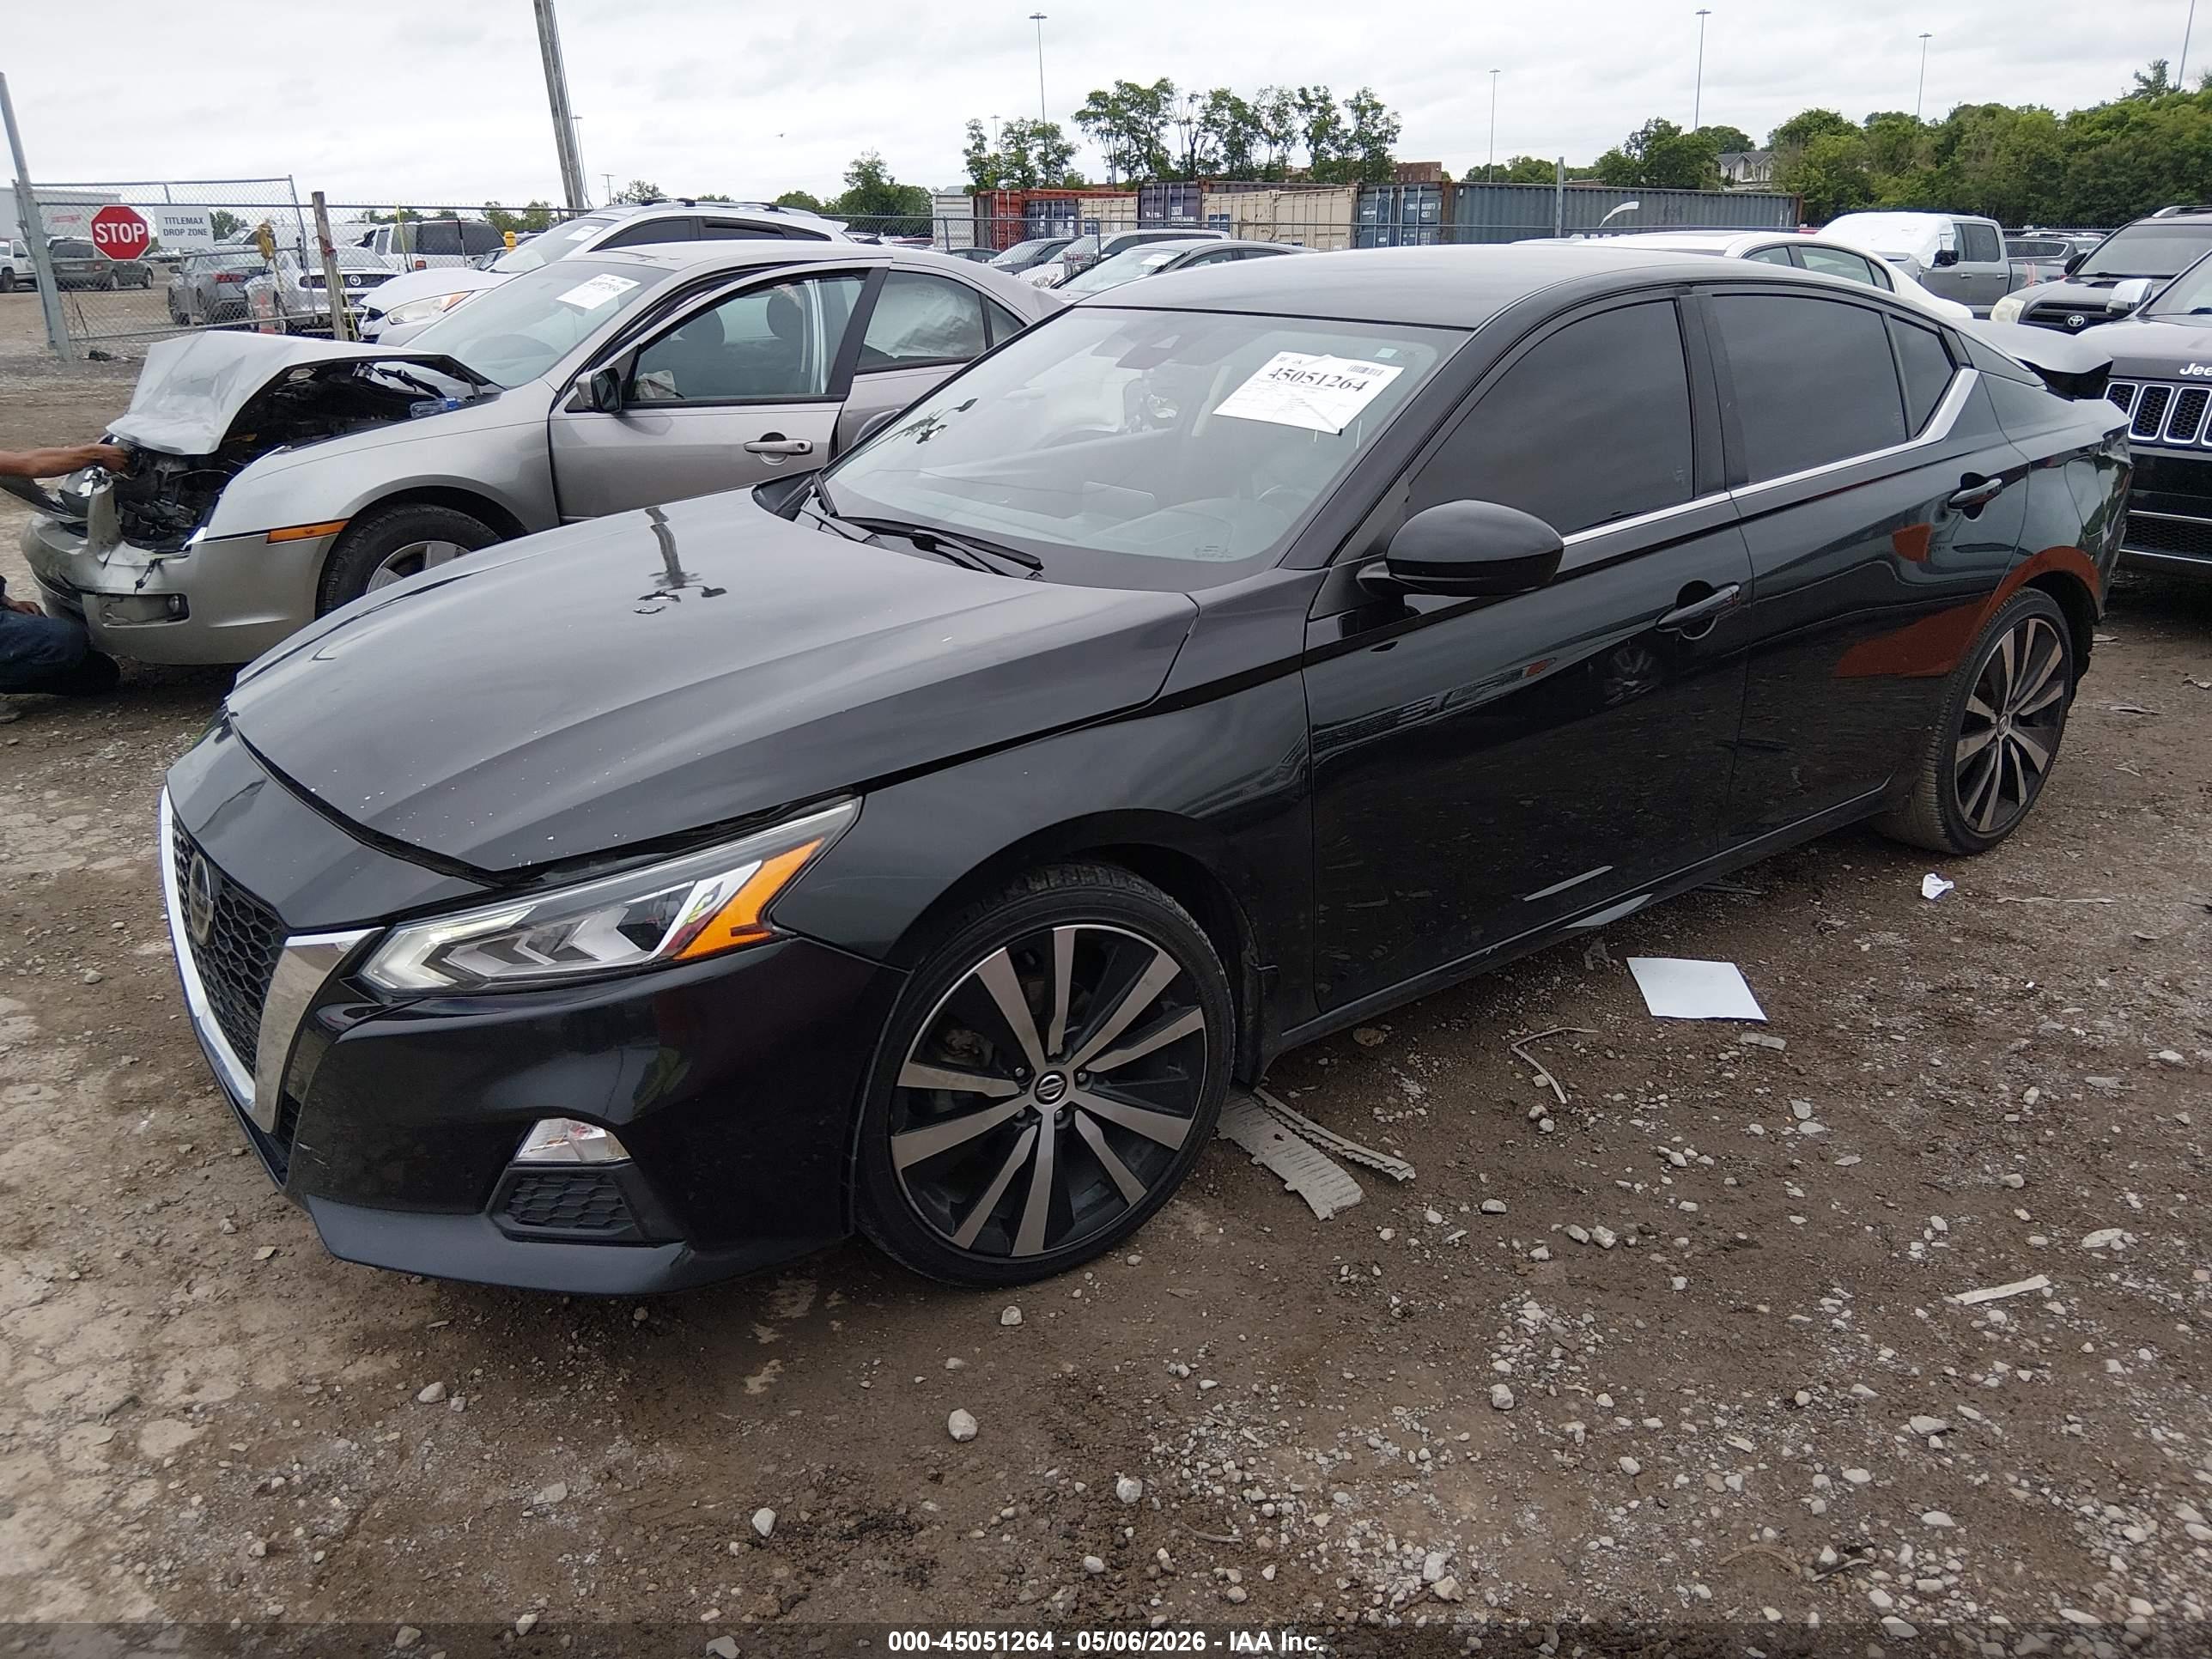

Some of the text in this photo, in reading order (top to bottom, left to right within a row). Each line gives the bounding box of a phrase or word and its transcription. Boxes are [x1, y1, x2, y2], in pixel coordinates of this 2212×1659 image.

[164, 216, 204, 225] TITLEMAX
[94, 222, 146, 244] STOP
[163, 228, 209, 237] DROP ZONE
[1267, 367, 1370, 392] 45051264
